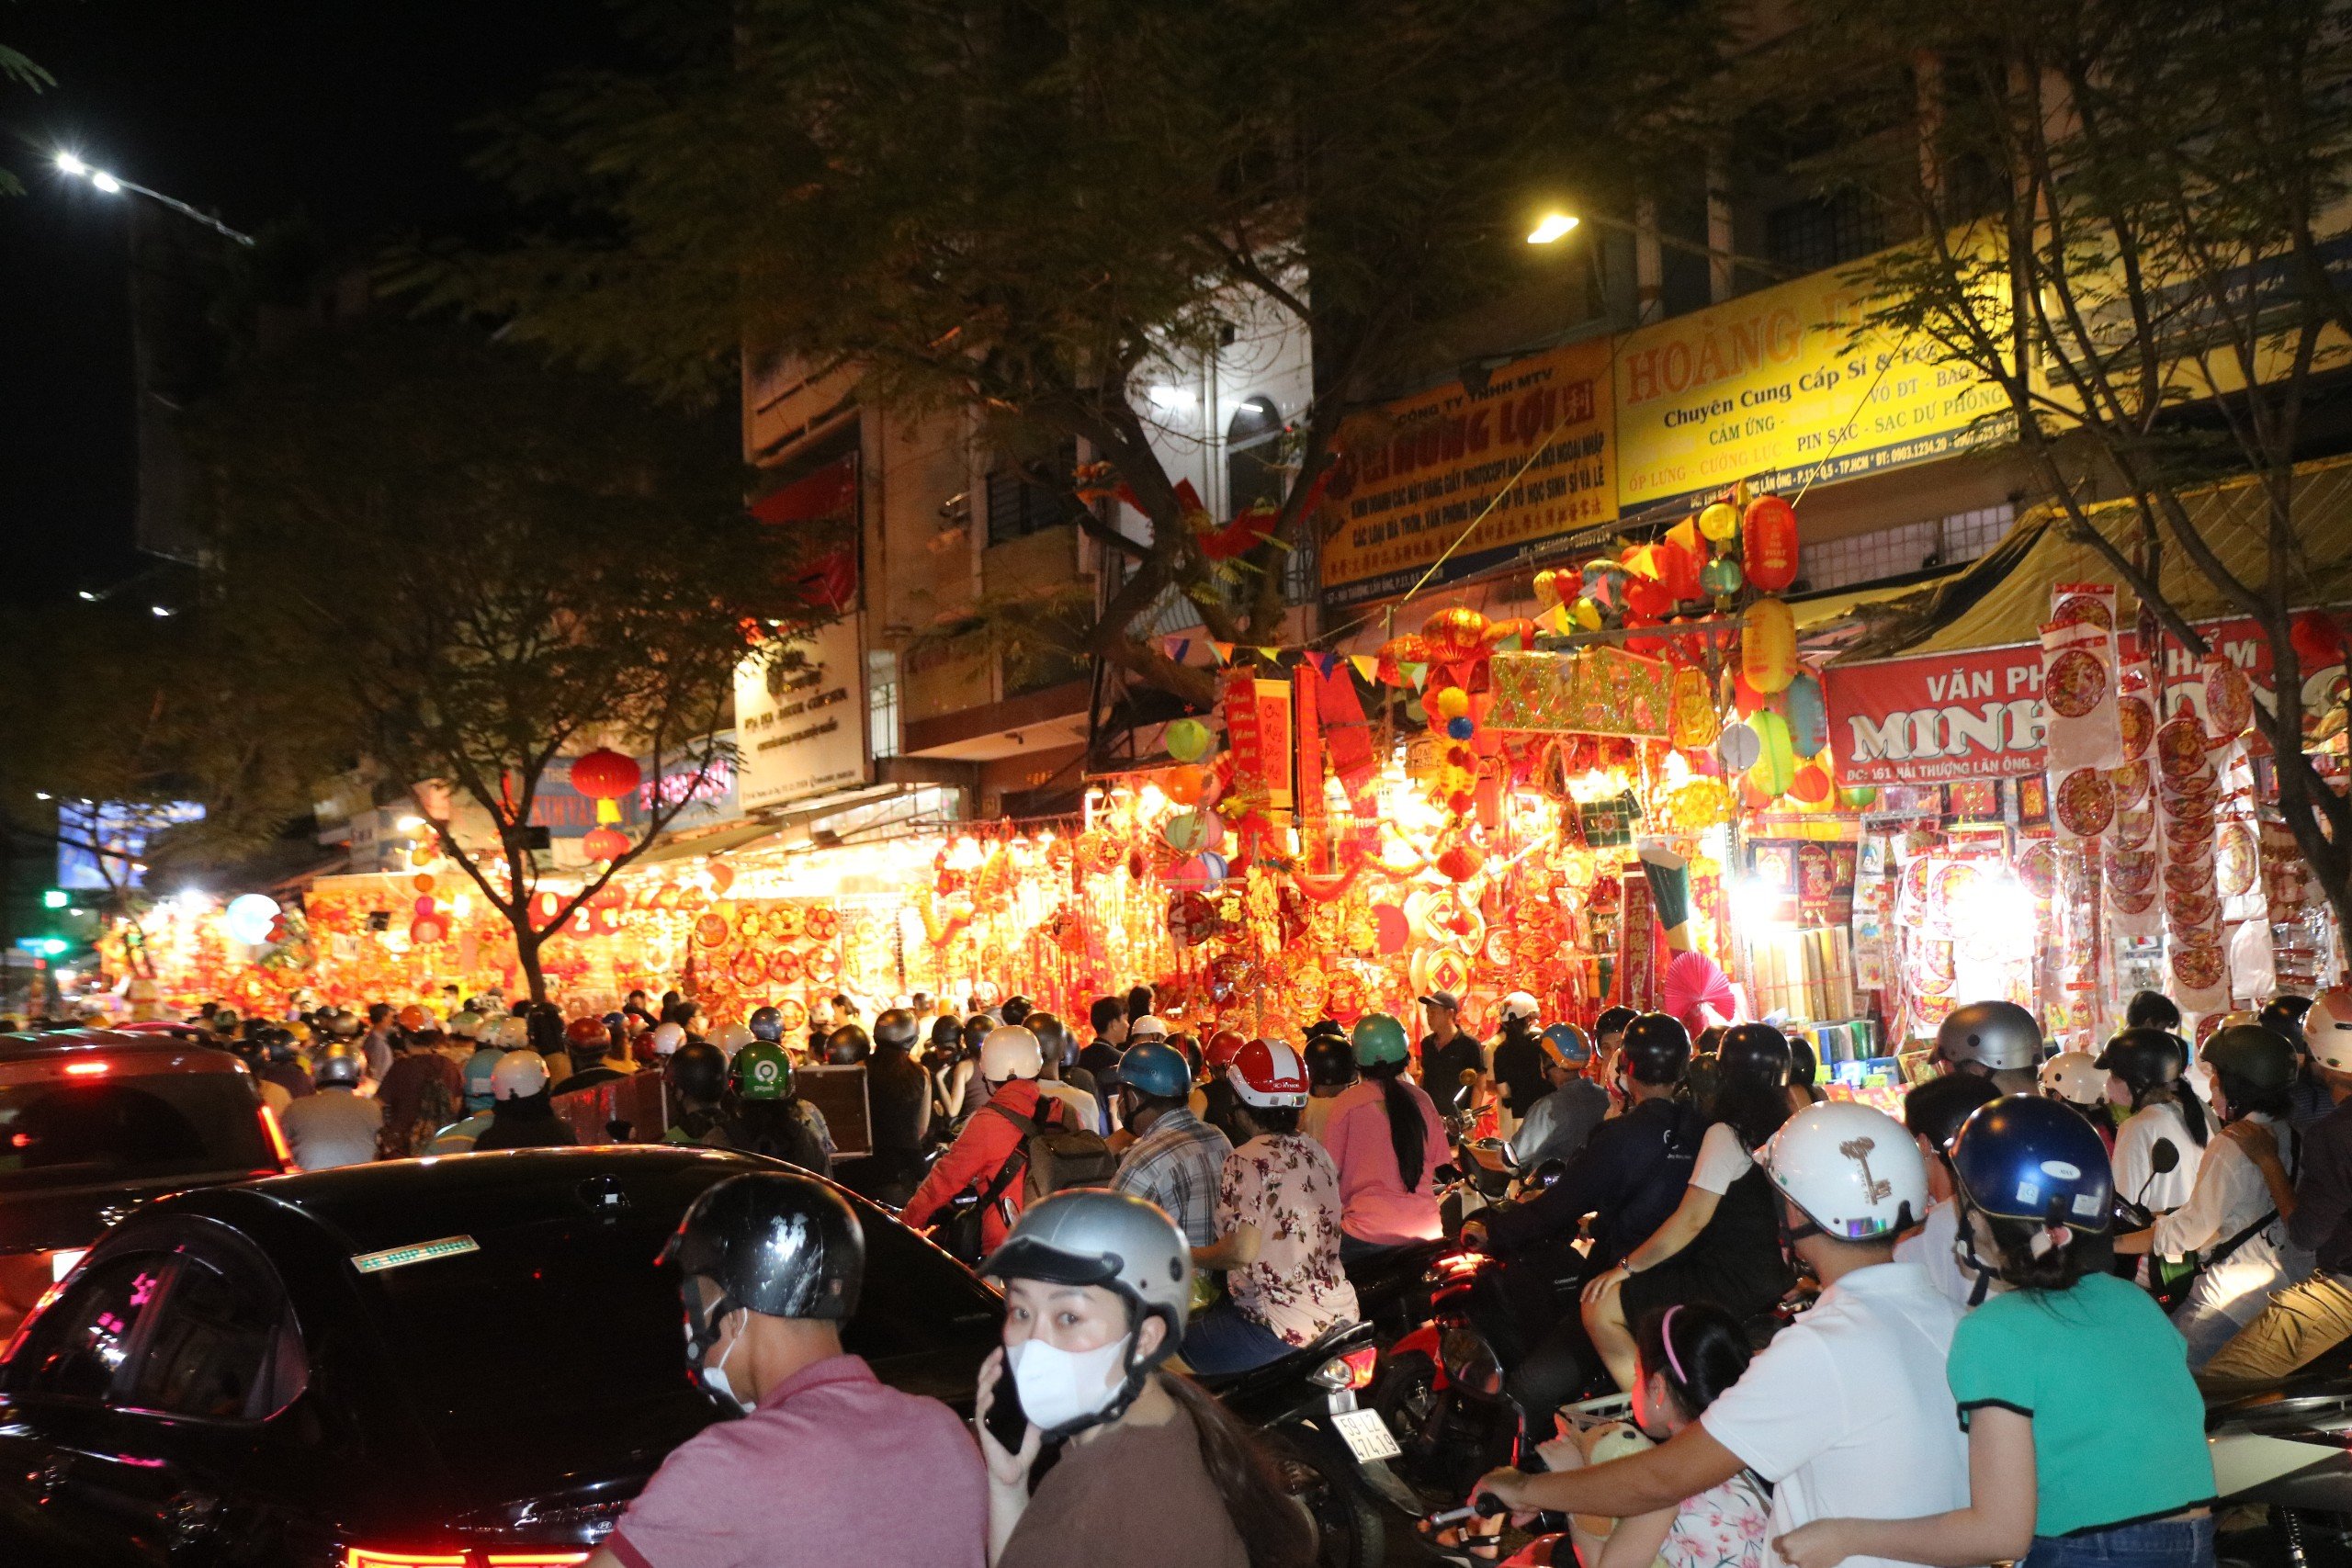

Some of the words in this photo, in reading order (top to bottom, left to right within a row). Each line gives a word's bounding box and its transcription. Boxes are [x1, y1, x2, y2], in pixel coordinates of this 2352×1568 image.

[1624, 308, 1803, 406] HOÀNG
[1445, 394, 1464, 412] TY
[1518, 367, 1554, 389] MTV
[1663, 398, 1735, 429] Chuyên
[1740, 382, 1792, 408] Cung
[1798, 365, 1840, 393] Cấp
[1745, 414, 1776, 436] ỨNG
[1797, 430, 1822, 453] PIN
[1827, 422, 1859, 446] SẠC
[1875, 411, 1907, 436] SẠC
[1820, 462, 1834, 480] Q.5
[1838, 455, 1870, 475] TP.HCM
[1926, 667, 1995, 703] VĂN
[1847, 769, 1868, 782] ĐC:
[1871, 768, 1892, 780] 161
[1919, 761, 1971, 779] THƯỢNG
[1974, 757, 1999, 773] LÃN
[2002, 755, 2030, 772] ÔNG
